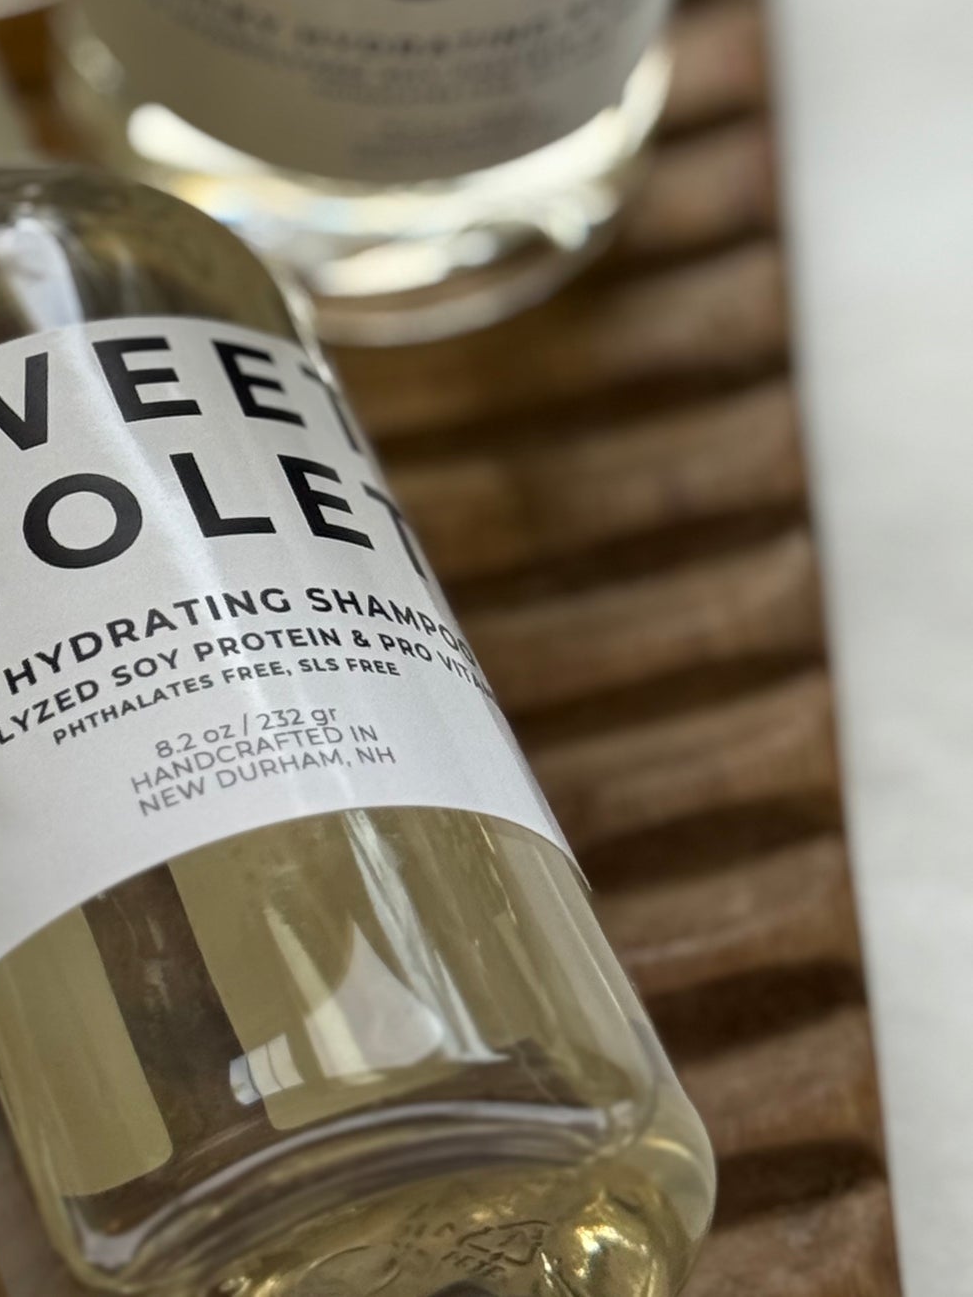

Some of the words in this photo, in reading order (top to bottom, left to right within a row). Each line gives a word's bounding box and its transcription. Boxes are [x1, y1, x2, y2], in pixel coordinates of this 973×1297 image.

[3, 587, 290, 695] HYDRATING
[111, 648, 179, 688] SOY
[193, 627, 342, 662] PROTEIN
[351, 629, 371, 648] &
[377, 633, 433, 663] PRO
[52, 674, 215, 745] PHTHALATES
[221, 660, 293, 685] FREE,
[298, 657, 340, 674] SLS
[346, 657, 401, 677] FREE
[154, 733, 198, 759] 8.2
[202, 723, 236, 745] oz
[255, 707, 305, 731] 232
[311, 705, 339, 727] gr
[130, 726, 344, 794] HANDCRAFTED
[349, 724, 379, 743] IN
[138, 776, 207, 817] NEW
[215, 748, 352, 790] DURHAM,
[355, 746, 397, 765] NH
